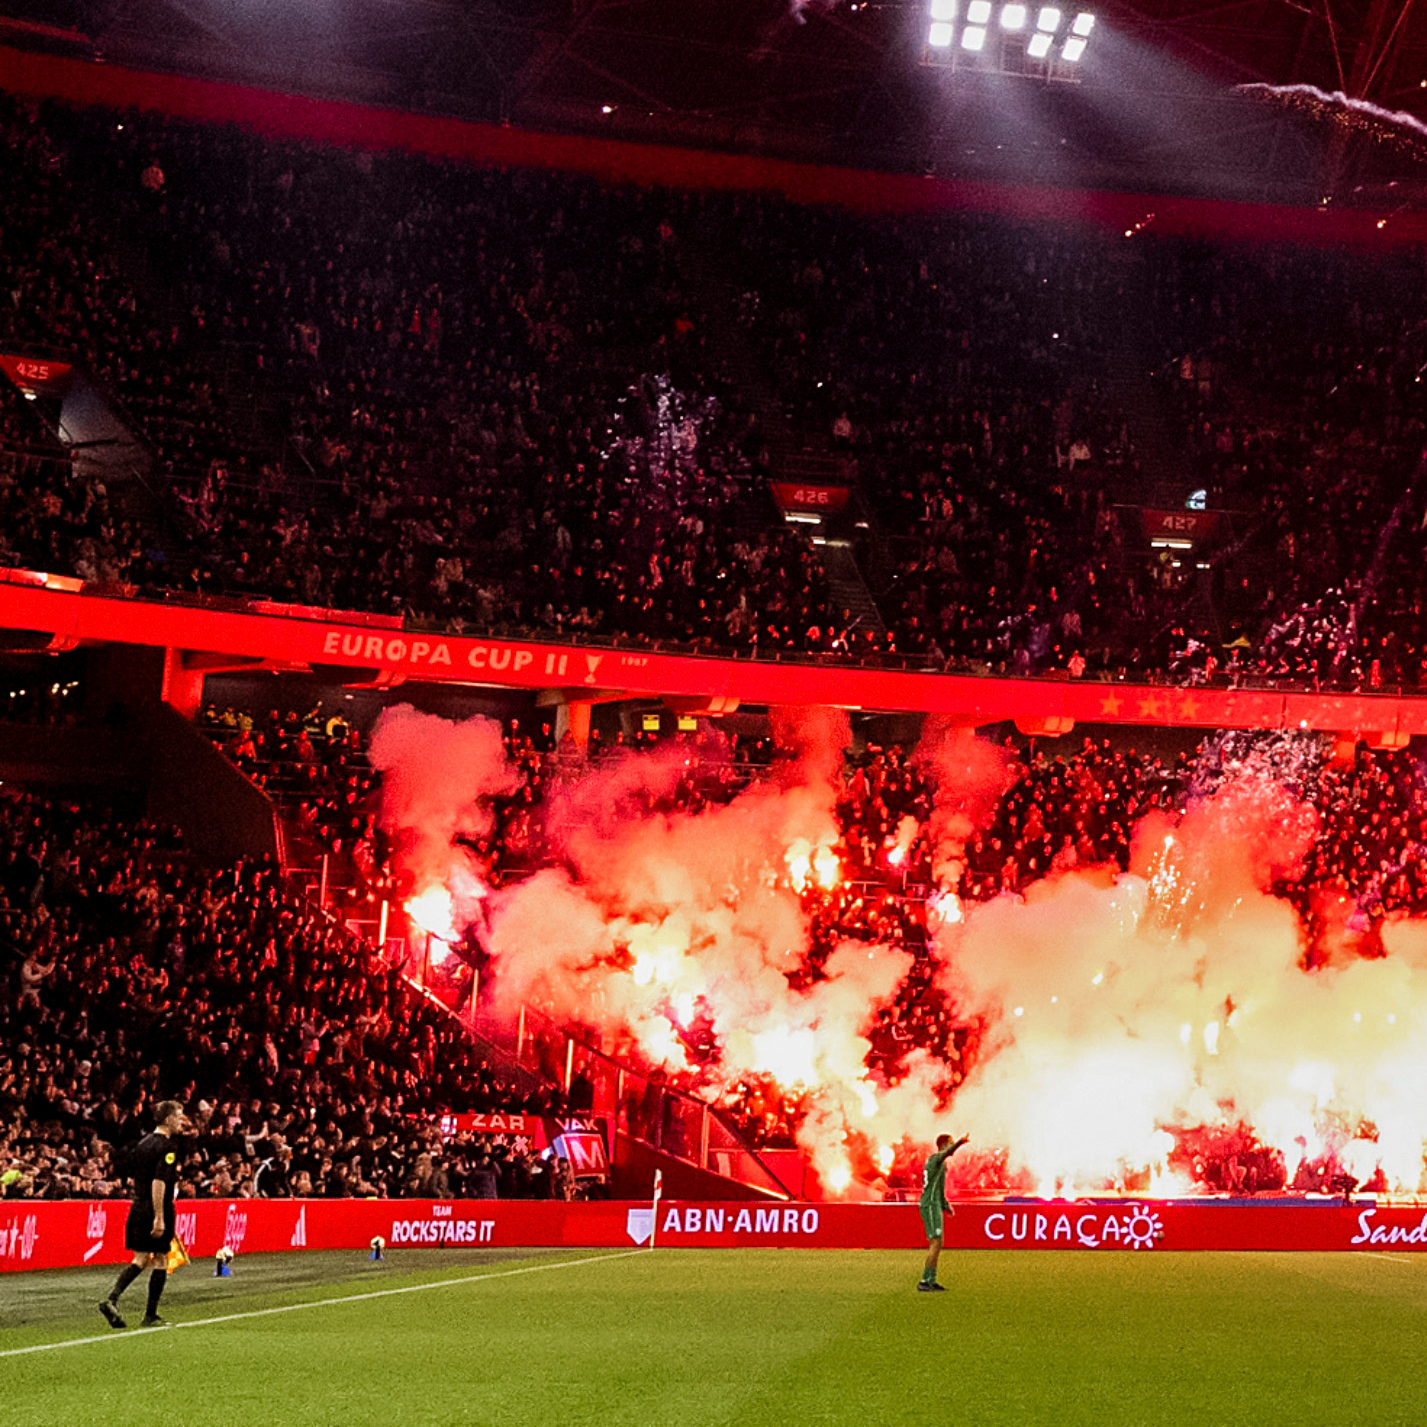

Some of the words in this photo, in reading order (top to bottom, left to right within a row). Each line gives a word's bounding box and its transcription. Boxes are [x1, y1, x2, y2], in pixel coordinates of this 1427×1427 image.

[322, 630, 452, 666] EUROPA
[467, 646, 534, 672] CUP
[545, 653, 569, 676] II
[471, 1113, 526, 1131] ZAR
[554, 1117, 600, 1132] VAK
[432, 1205, 453, 1217] TEAM
[391, 1220, 476, 1243] ROCKSTARS
[479, 1220, 496, 1242] IT
